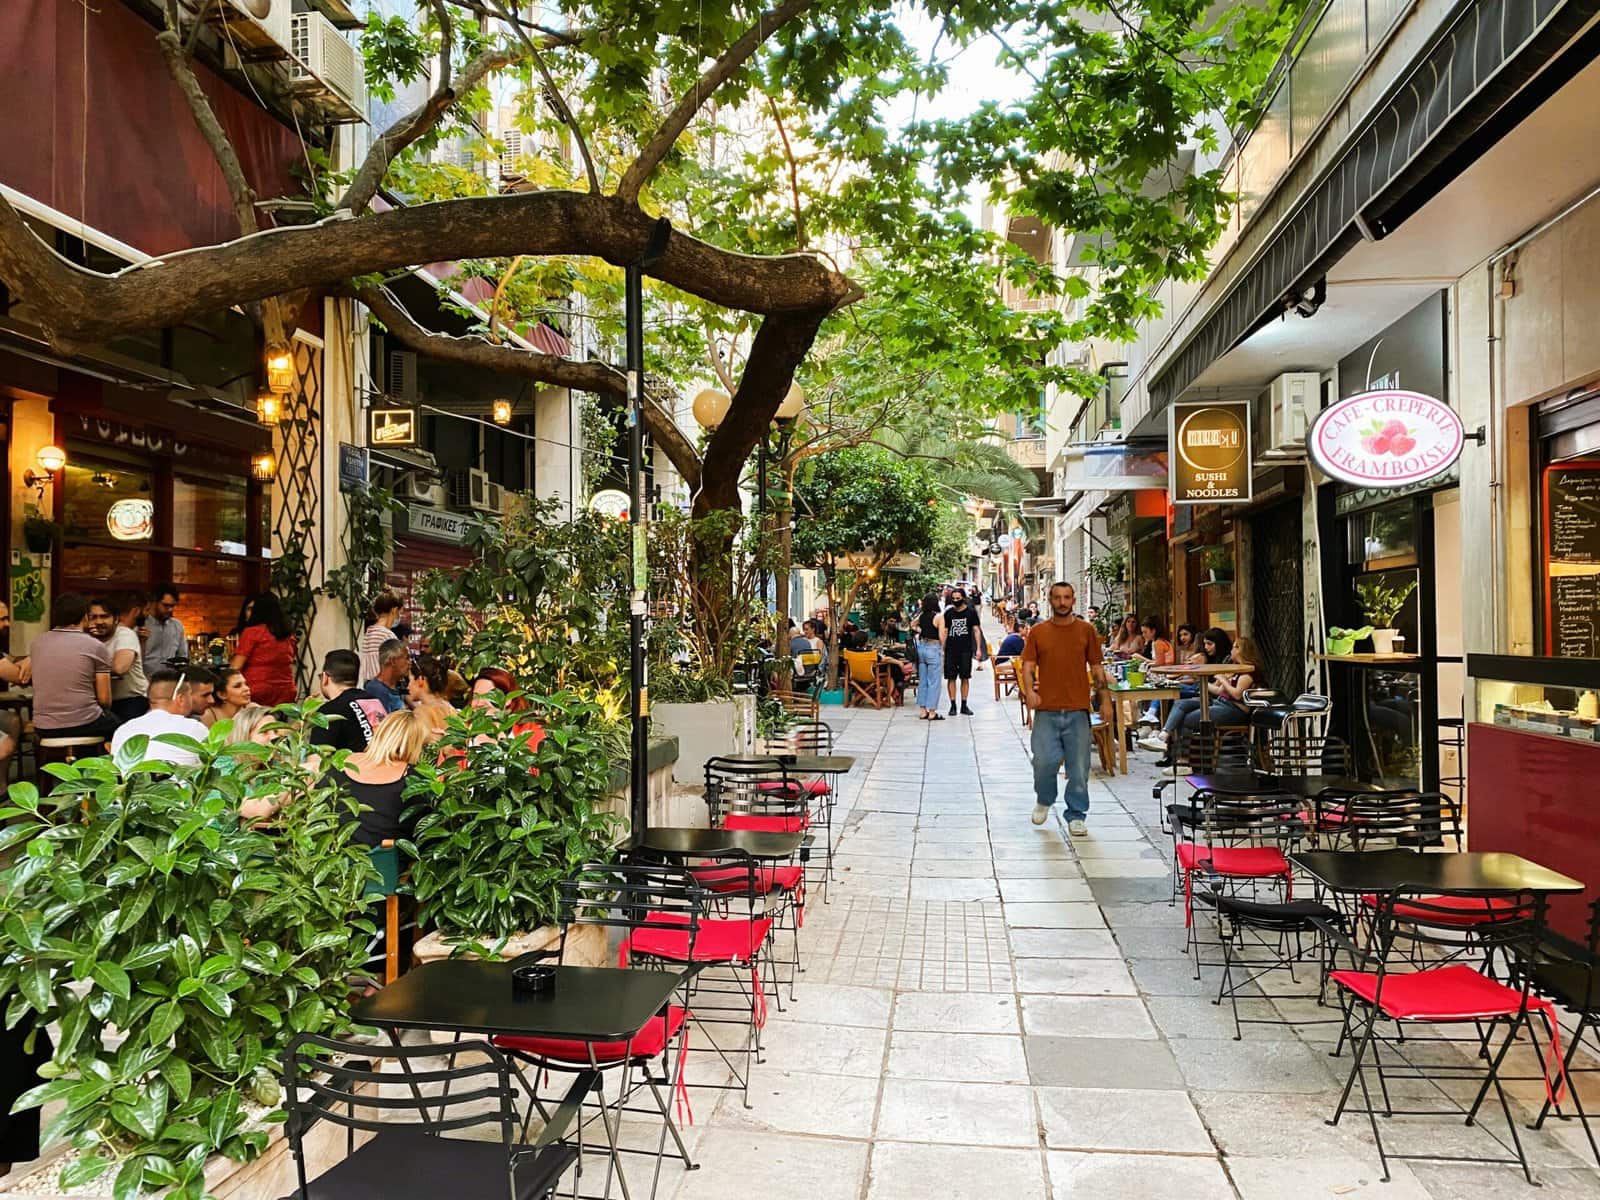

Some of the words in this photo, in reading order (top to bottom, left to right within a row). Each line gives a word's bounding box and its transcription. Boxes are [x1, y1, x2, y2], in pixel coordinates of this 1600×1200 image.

[1331, 442, 1449, 476] FRAMBOISE
[1194, 472, 1228, 482] SUSHI
[1207, 481, 1216, 489] &
[1185, 488, 1239, 498] NOODLES
[420, 513, 458, 533] ΓΡΑΦΙΚΕΣ
